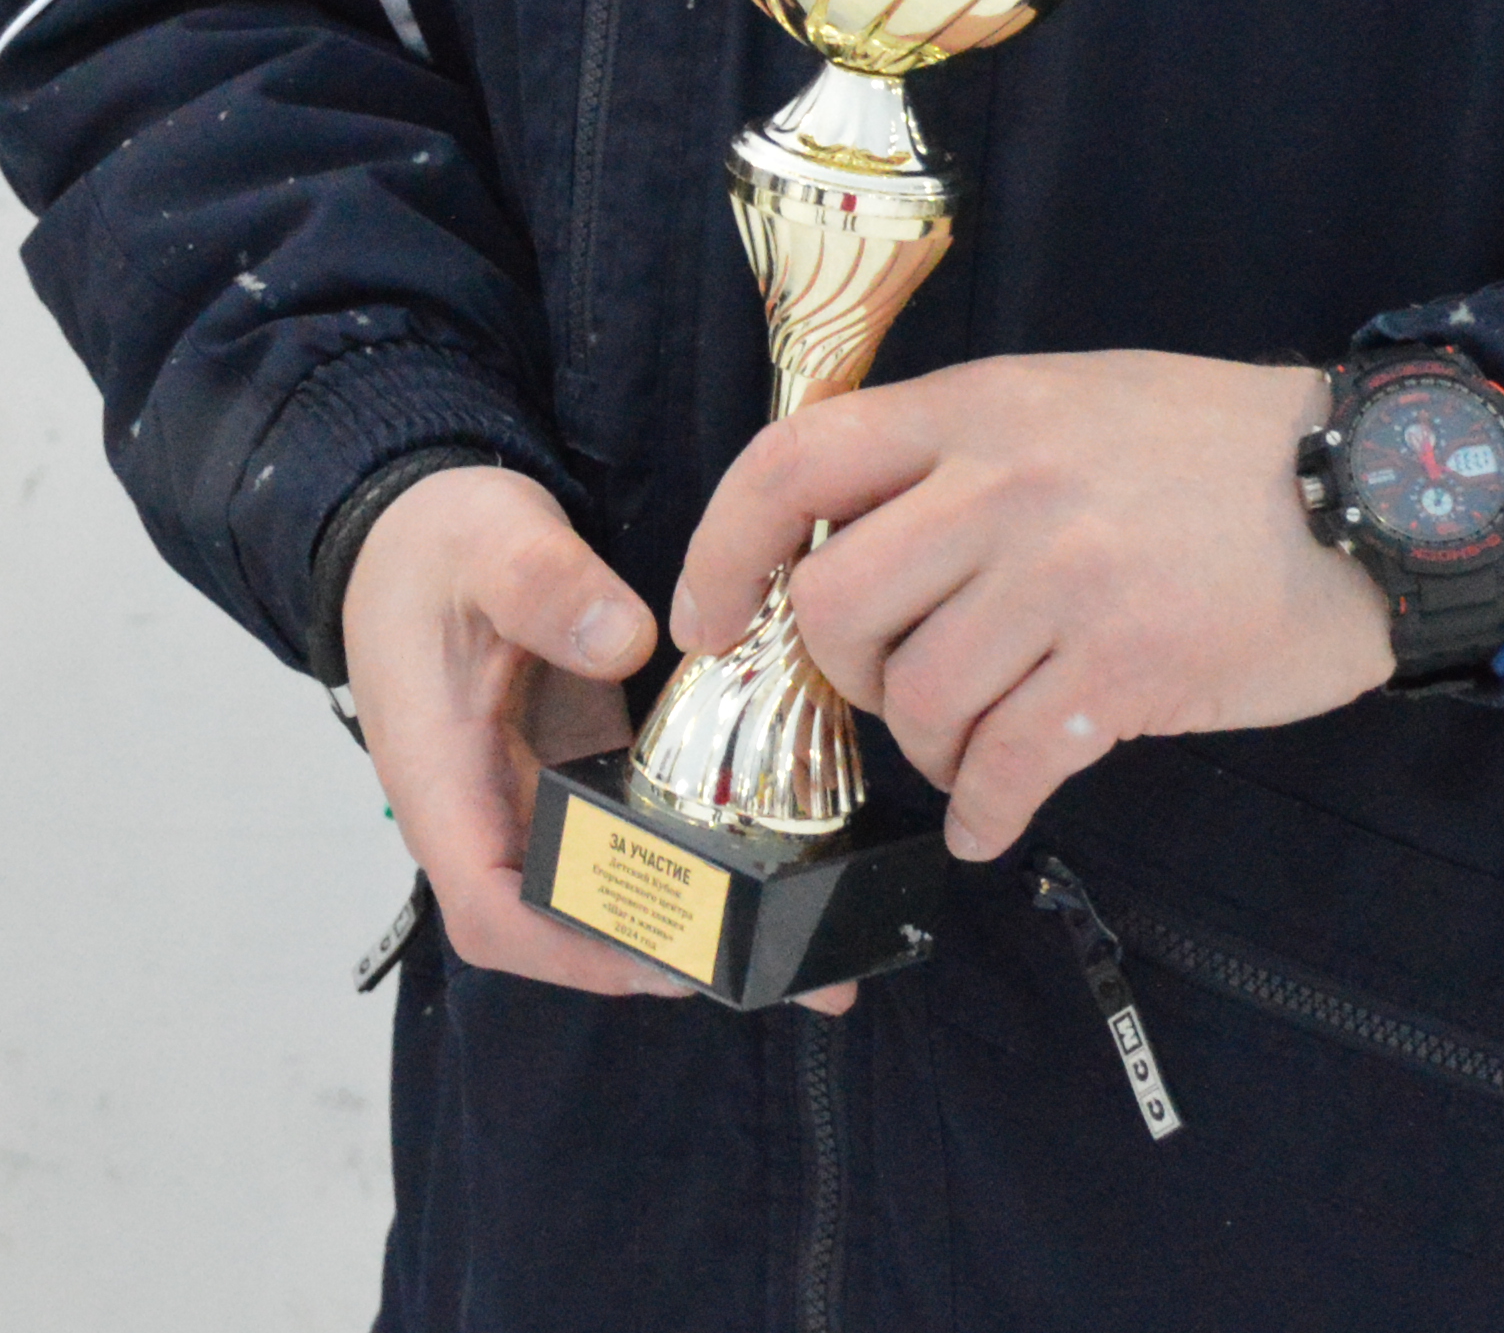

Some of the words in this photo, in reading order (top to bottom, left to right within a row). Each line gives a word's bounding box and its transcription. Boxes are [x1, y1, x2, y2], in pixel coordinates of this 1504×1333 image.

[610, 833, 626, 854] ЗА
[630, 841, 691, 885] УЧАСТИЕ
[615, 921, 638, 940] 2024
[1113, 1012, 1166, 1122] CCM
